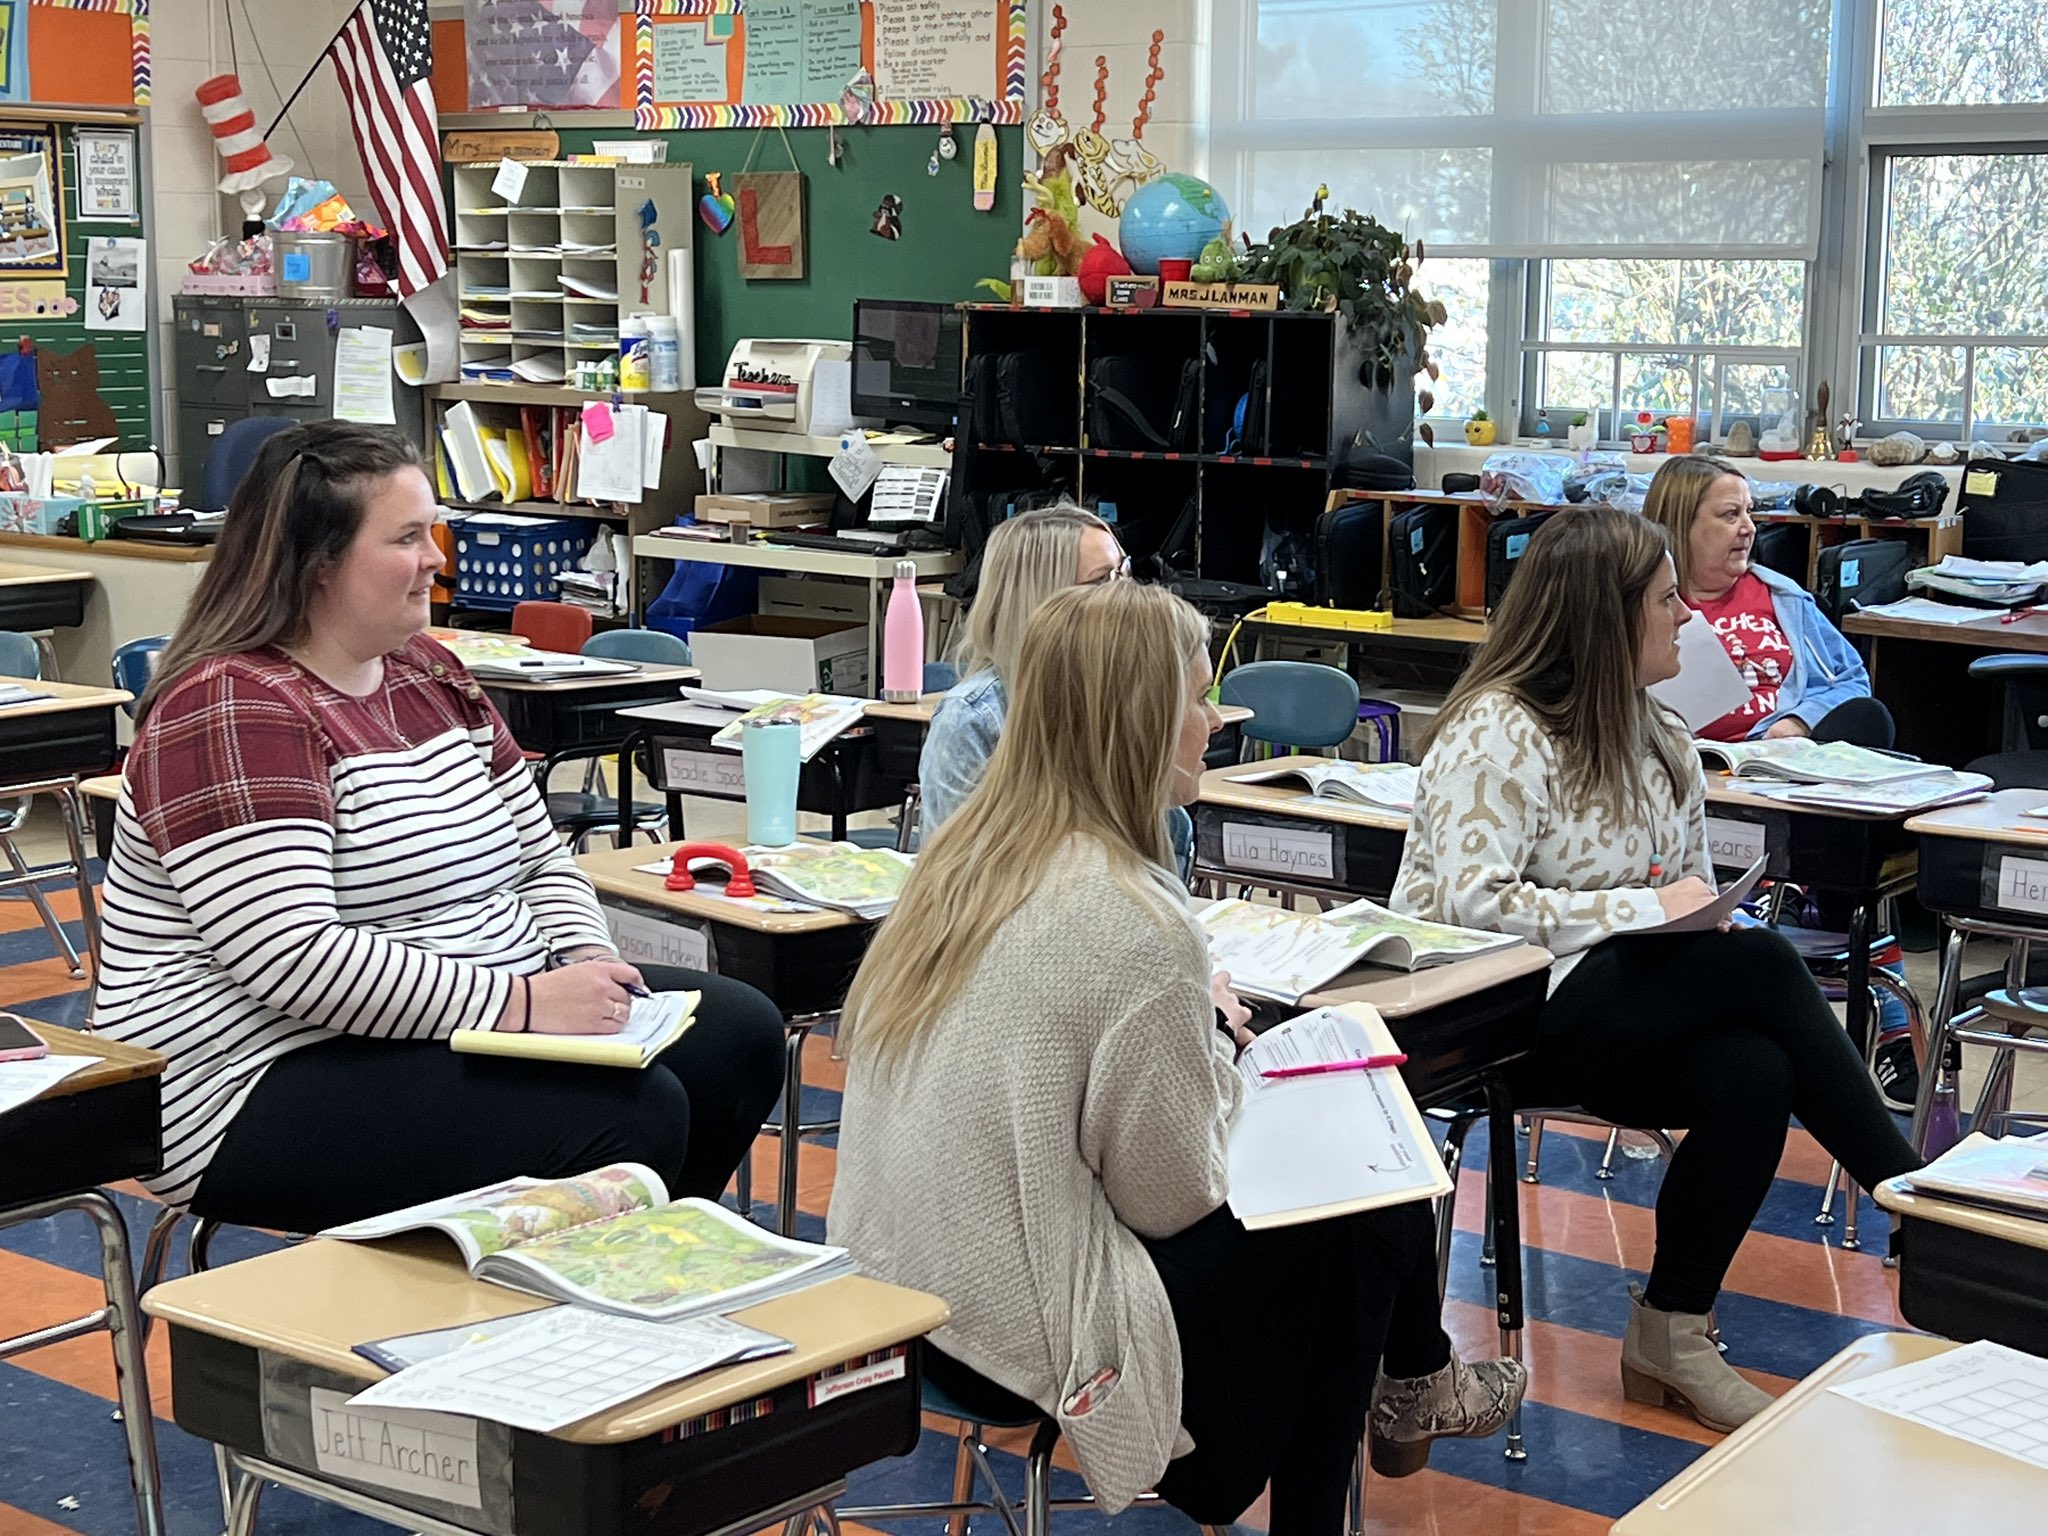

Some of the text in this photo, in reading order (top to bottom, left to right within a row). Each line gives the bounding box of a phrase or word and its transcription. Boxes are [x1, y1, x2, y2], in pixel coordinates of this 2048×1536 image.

[883, 15, 905, 24] Please
[970, 9, 993, 19] other
[883, 25, 906, 35] people
[883, 37, 909, 46] Please
[915, 34, 935, 45] listen
[940, 31, 971, 44] carefully
[975, 33, 991, 42] and
[911, 47, 947, 56] directions
[741, 189, 792, 264] L
[1168, 288, 1198, 300] MRS
[1211, 290, 1268, 305] LANMAN
[733, 361, 792, 386] Teachers
[1709, 611, 1781, 636] CHER
[1757, 634, 1793, 656] AL
[1229, 833, 1327, 873] Lila Haynes
[1707, 839, 1753, 859] ears
[661, 934, 703, 969] Hokey
[318, 1407, 470, 1485] Jeff Archer
